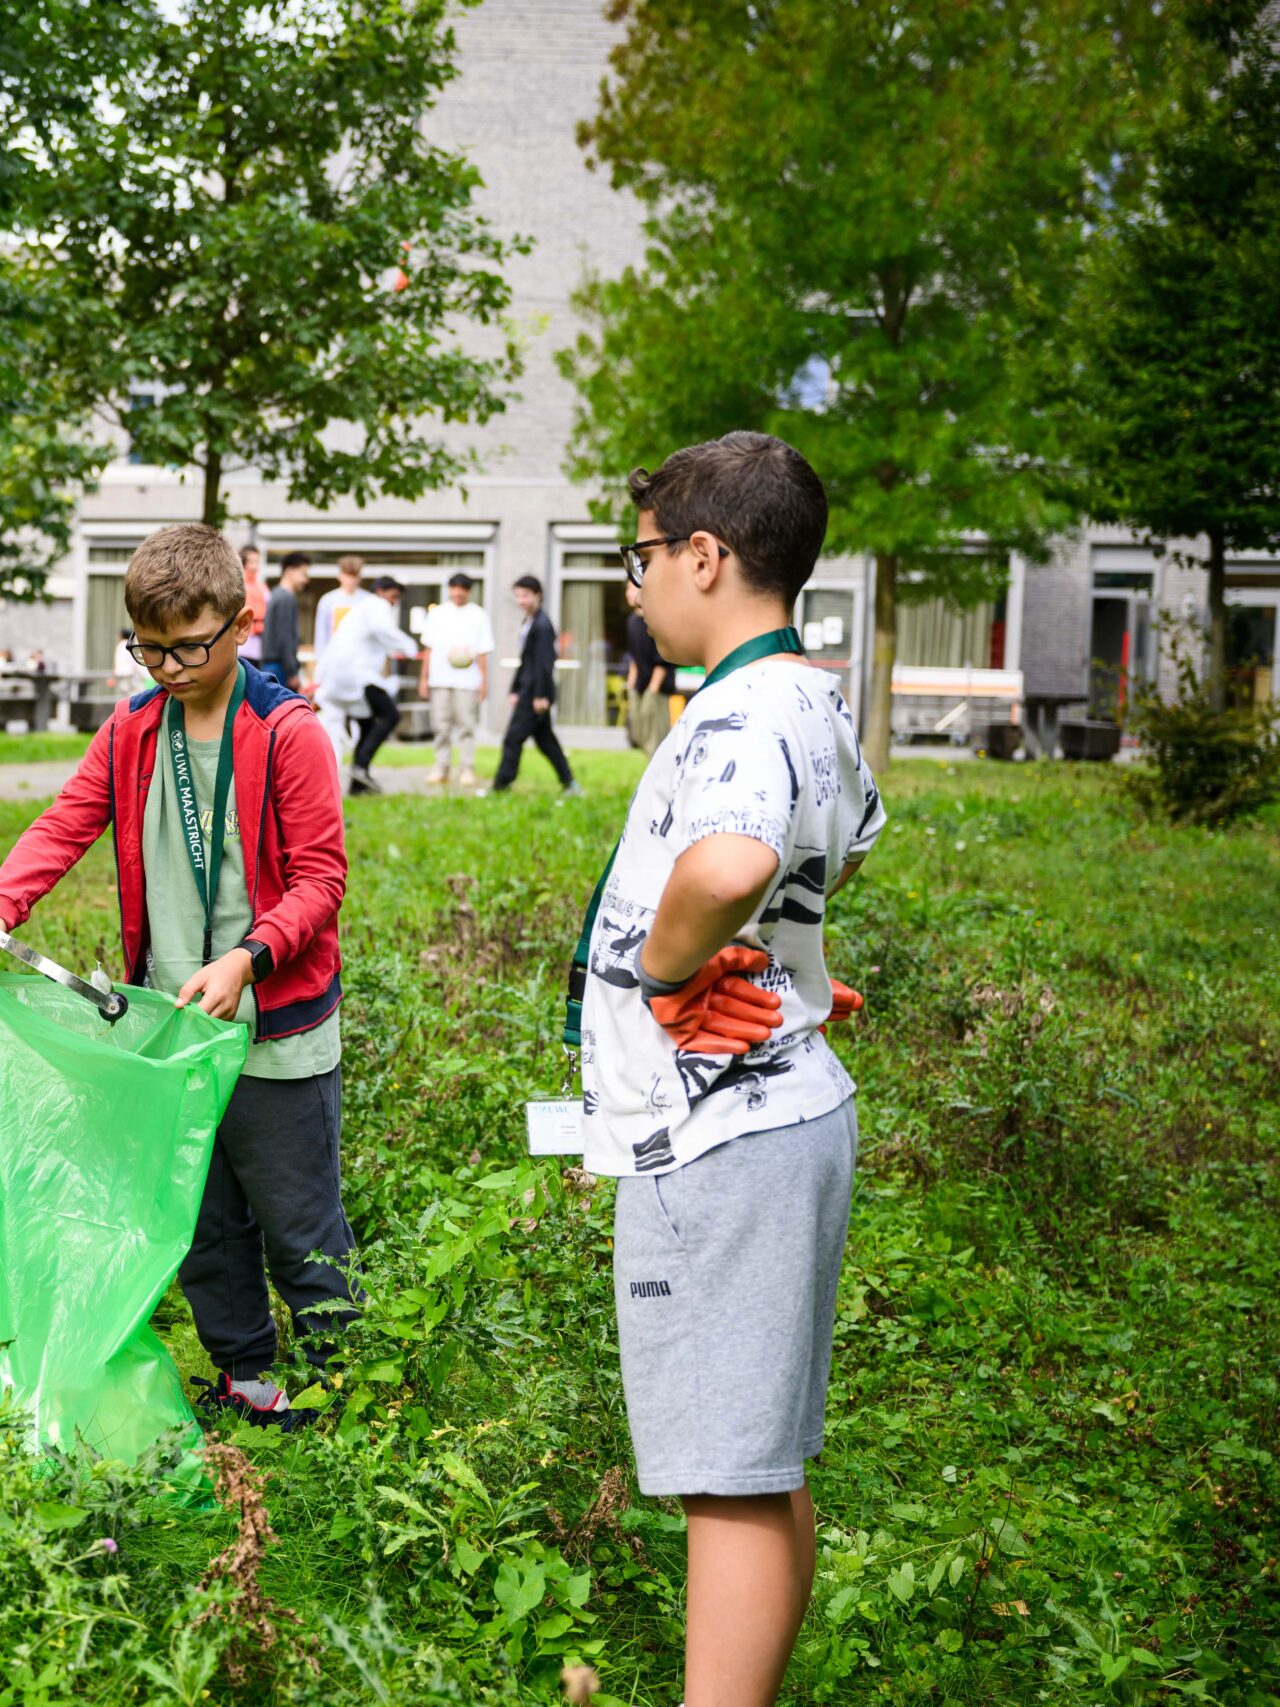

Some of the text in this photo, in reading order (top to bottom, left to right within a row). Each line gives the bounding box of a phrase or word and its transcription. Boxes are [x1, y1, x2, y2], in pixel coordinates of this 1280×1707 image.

[174, 753, 205, 870] UWC MAASTRICHT
[630, 1280, 672, 1298] PUMA
